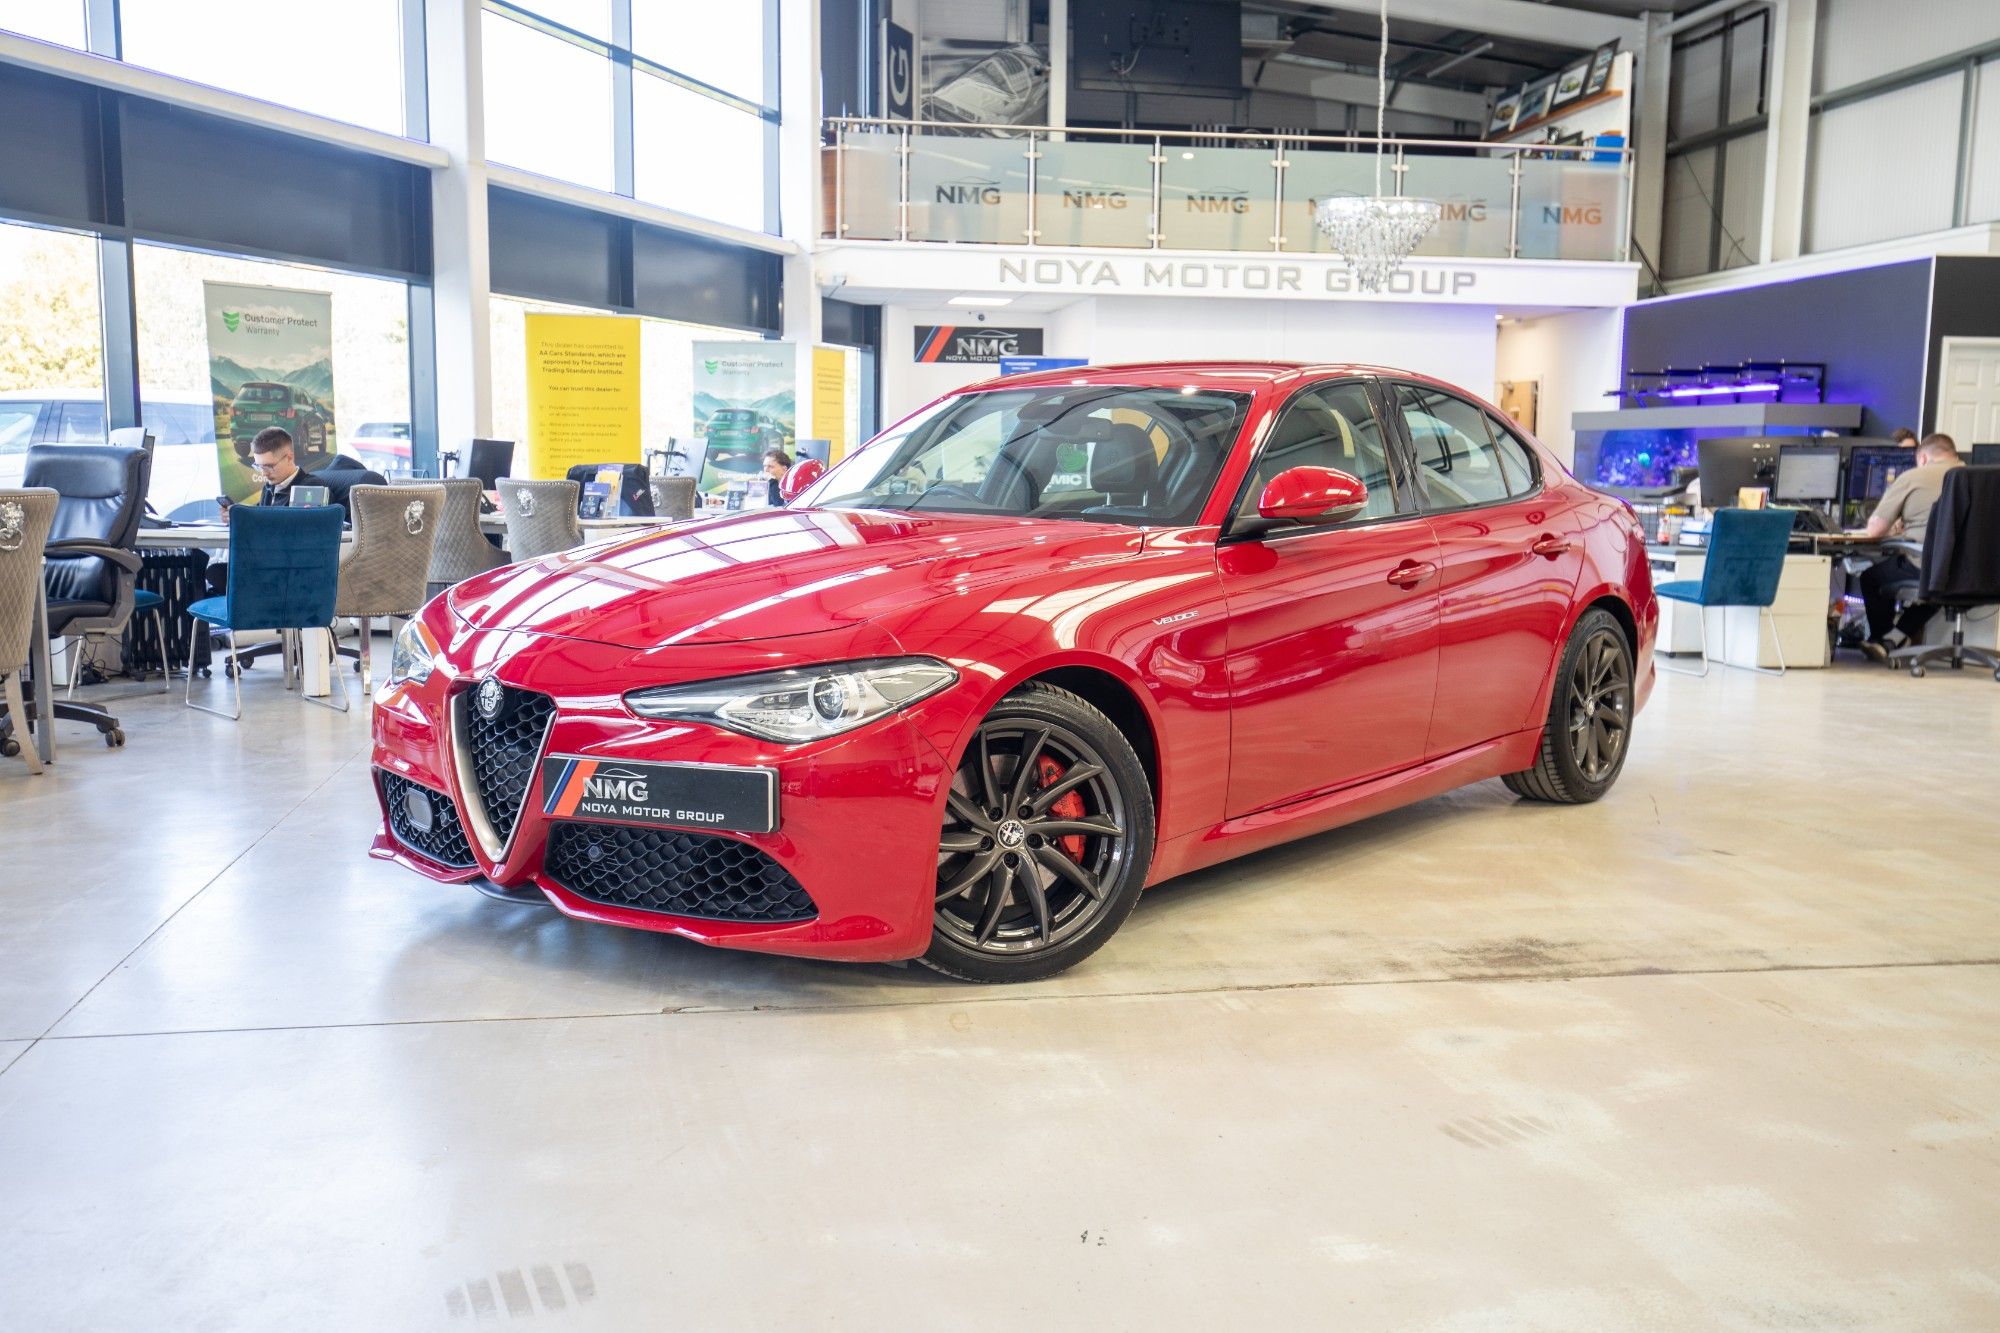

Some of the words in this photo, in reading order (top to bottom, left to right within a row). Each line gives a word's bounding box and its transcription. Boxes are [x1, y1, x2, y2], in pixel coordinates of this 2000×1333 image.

[935, 184, 1002, 206] NMG
[1062, 189, 1128, 209] NMG
[1186, 194, 1250, 214] NMG
[1542, 205, 1602, 226] NMG
[999, 257, 1121, 286] NOYA
[1144, 261, 1302, 291] MOTOR
[244, 313, 285, 325] Customer
[287, 317, 318, 328] Protect
[246, 325, 281, 337] Warranty
[956, 337, 1020, 356] NMG
[721, 360, 756, 368] Customer
[757, 361, 784, 369] Protect
[969, 355, 999, 363] MOTOR
[542, 367, 565, 375] Trading
[582, 776, 649, 802] NMG
[581, 801, 617, 814] NOYA
[622, 805, 671, 819] MOTOR
[676, 809, 725, 823] GROUP
